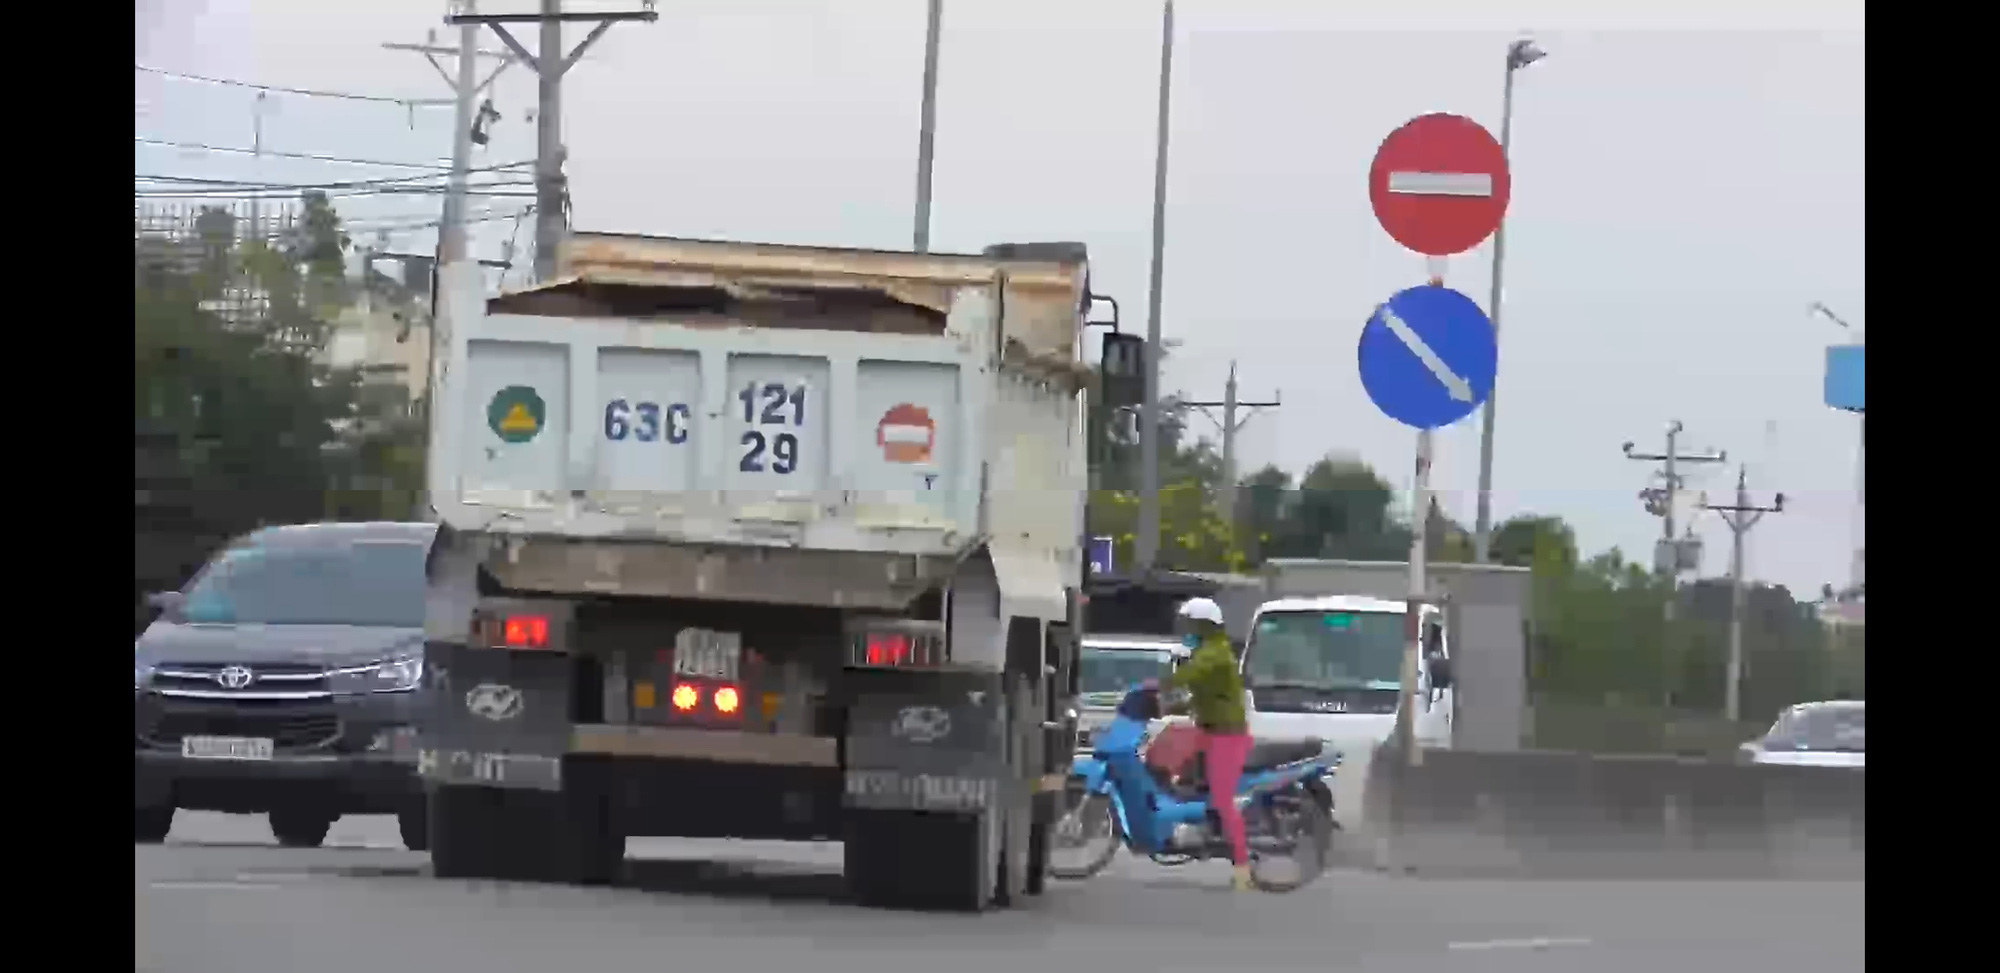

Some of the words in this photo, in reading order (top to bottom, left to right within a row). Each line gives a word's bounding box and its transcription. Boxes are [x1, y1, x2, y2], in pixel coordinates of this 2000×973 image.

[605, 399, 691, 444] 63C
[738, 380, 806, 426] 121
[739, 430, 799, 474] 29
